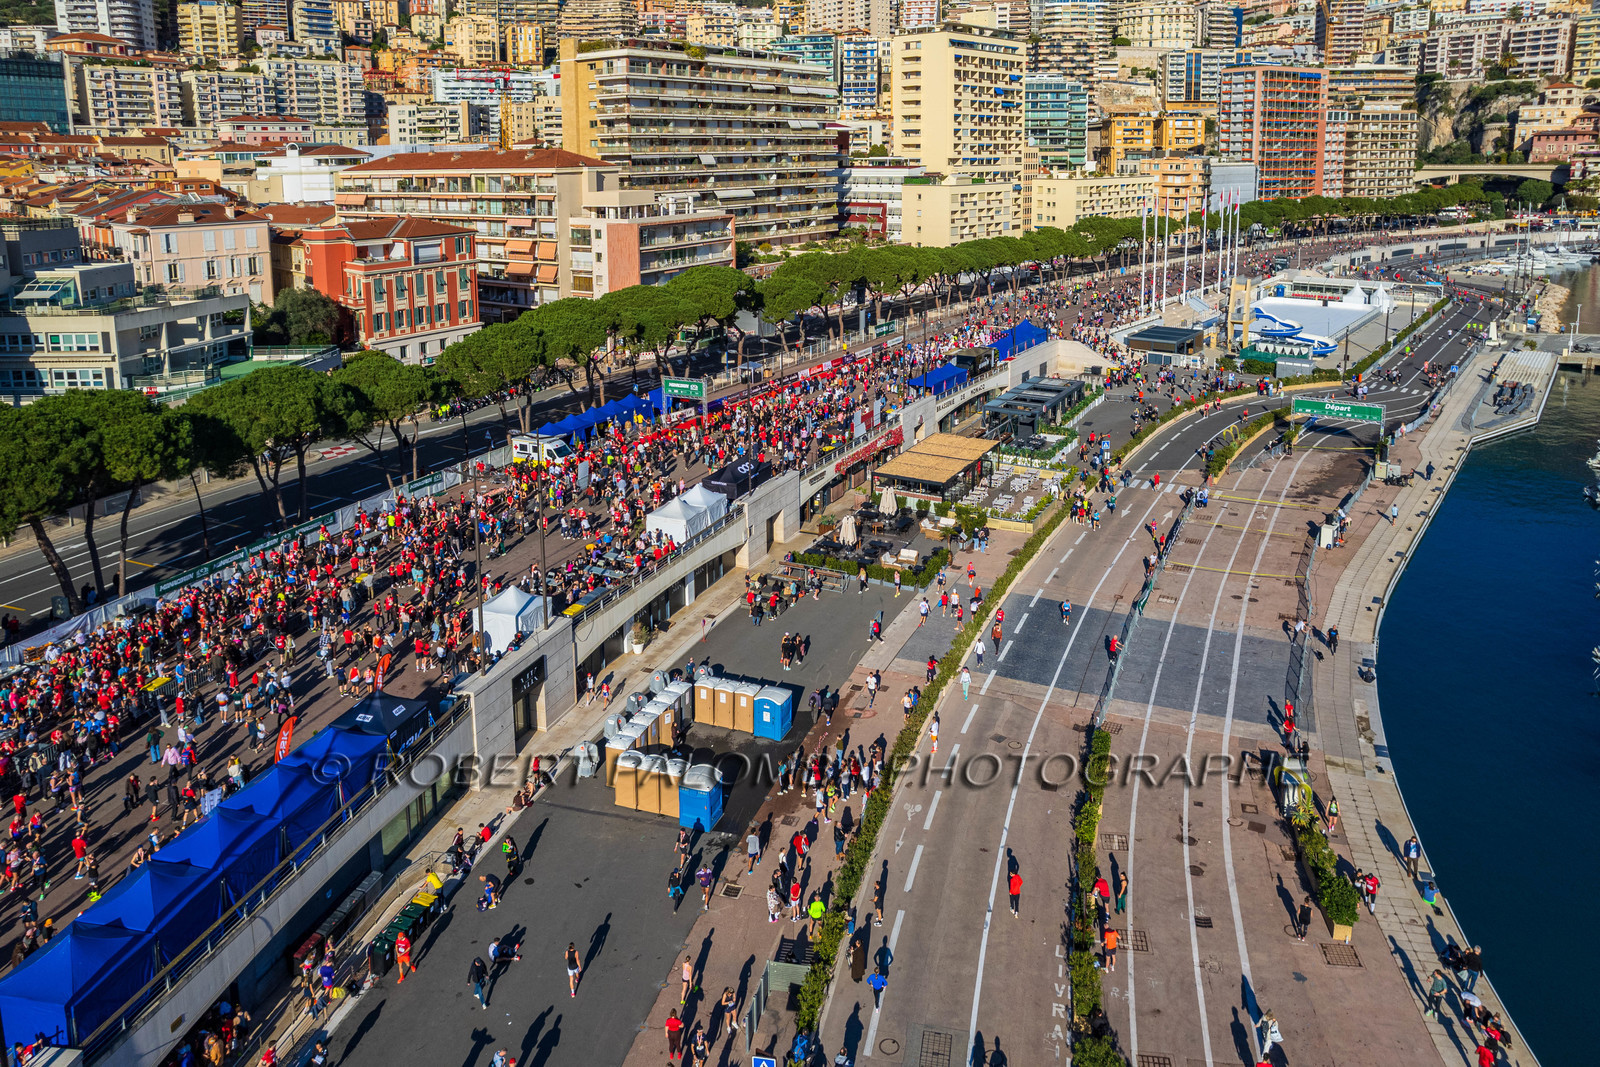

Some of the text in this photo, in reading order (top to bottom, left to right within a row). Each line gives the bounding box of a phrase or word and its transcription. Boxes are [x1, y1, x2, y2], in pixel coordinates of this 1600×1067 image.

[960, 393, 966, 401] DE
[970, 383, 986, 396] MONACO
[1324, 403, 1352, 413] Départ
